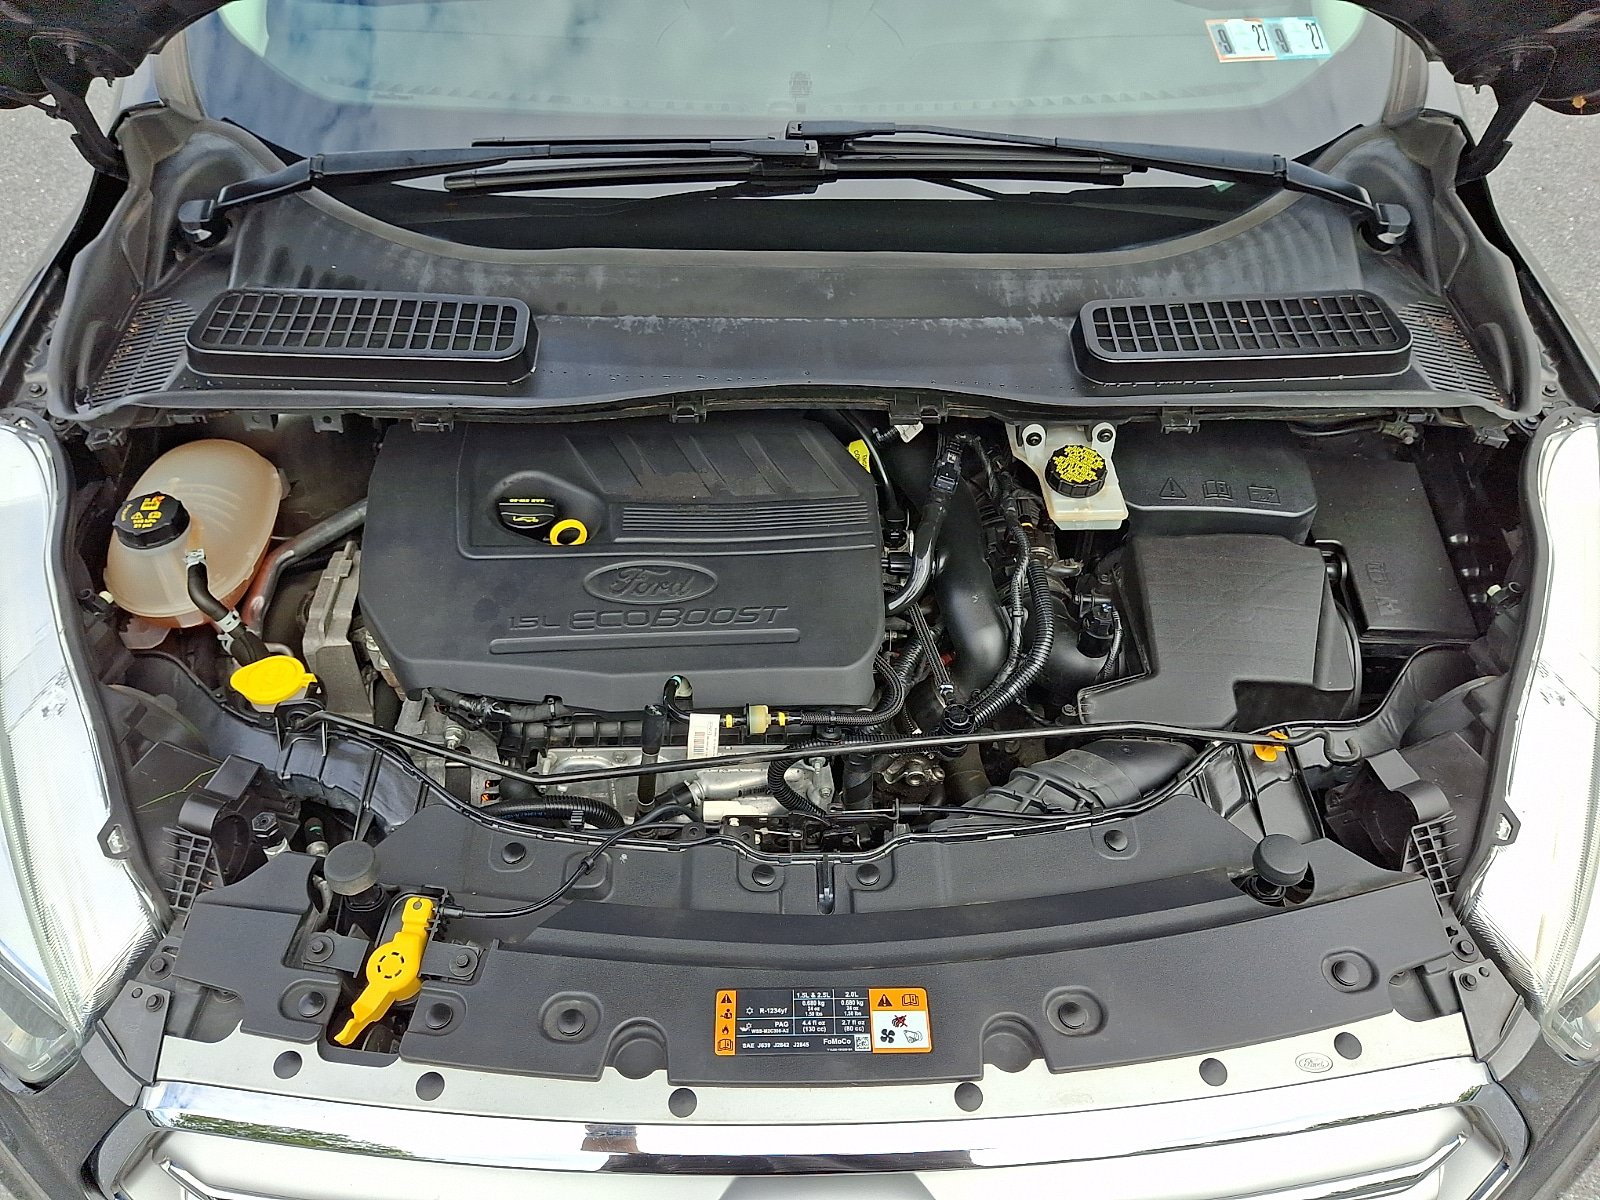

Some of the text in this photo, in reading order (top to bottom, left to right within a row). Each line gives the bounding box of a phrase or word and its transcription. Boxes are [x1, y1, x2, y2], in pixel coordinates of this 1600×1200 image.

[1252, 24, 1269, 51] 27
[1305, 22, 1324, 49] 27
[608, 567, 696, 598] Ford
[508, 615, 561, 631] 1.5L
[759, 1007, 788, 1015] R-1234yf
